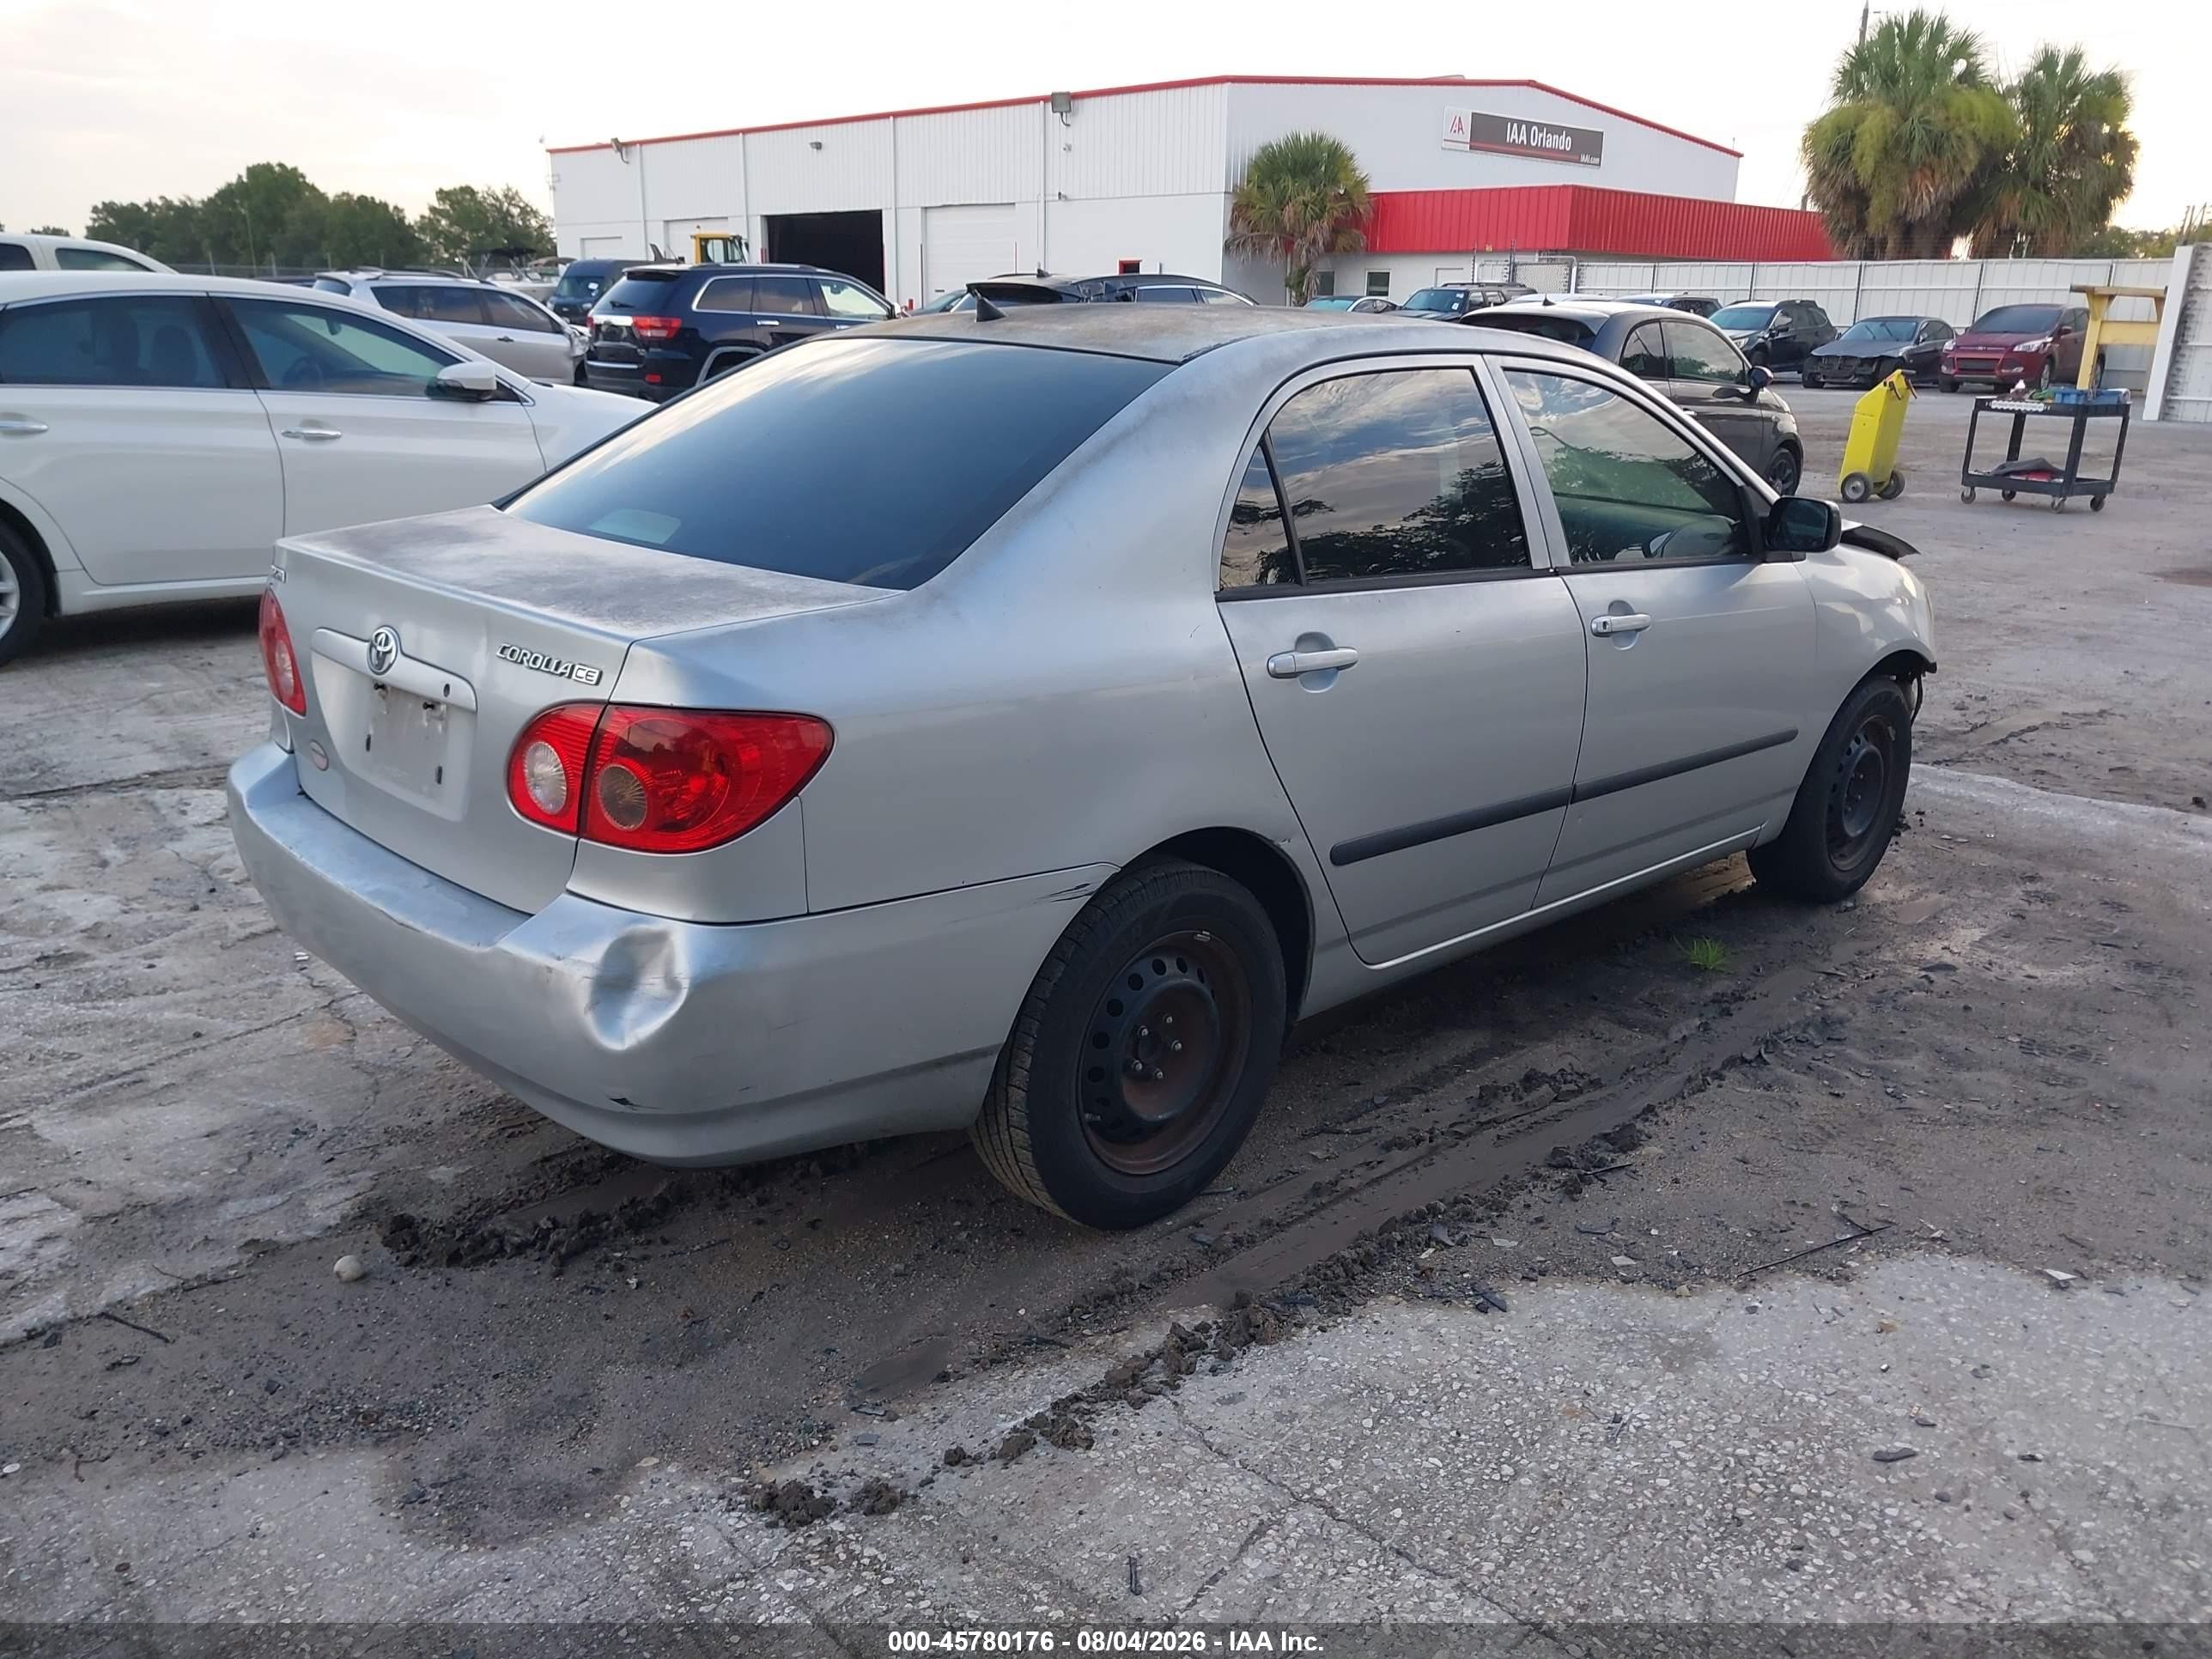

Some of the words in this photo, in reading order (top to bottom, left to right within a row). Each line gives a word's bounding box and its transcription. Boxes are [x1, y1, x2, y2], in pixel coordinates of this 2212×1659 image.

[1506, 122, 1527, 145] IAA
[1530, 126, 1572, 151] Orlando
[496, 643, 574, 679] COROLLA
[574, 665, 600, 685] CE
